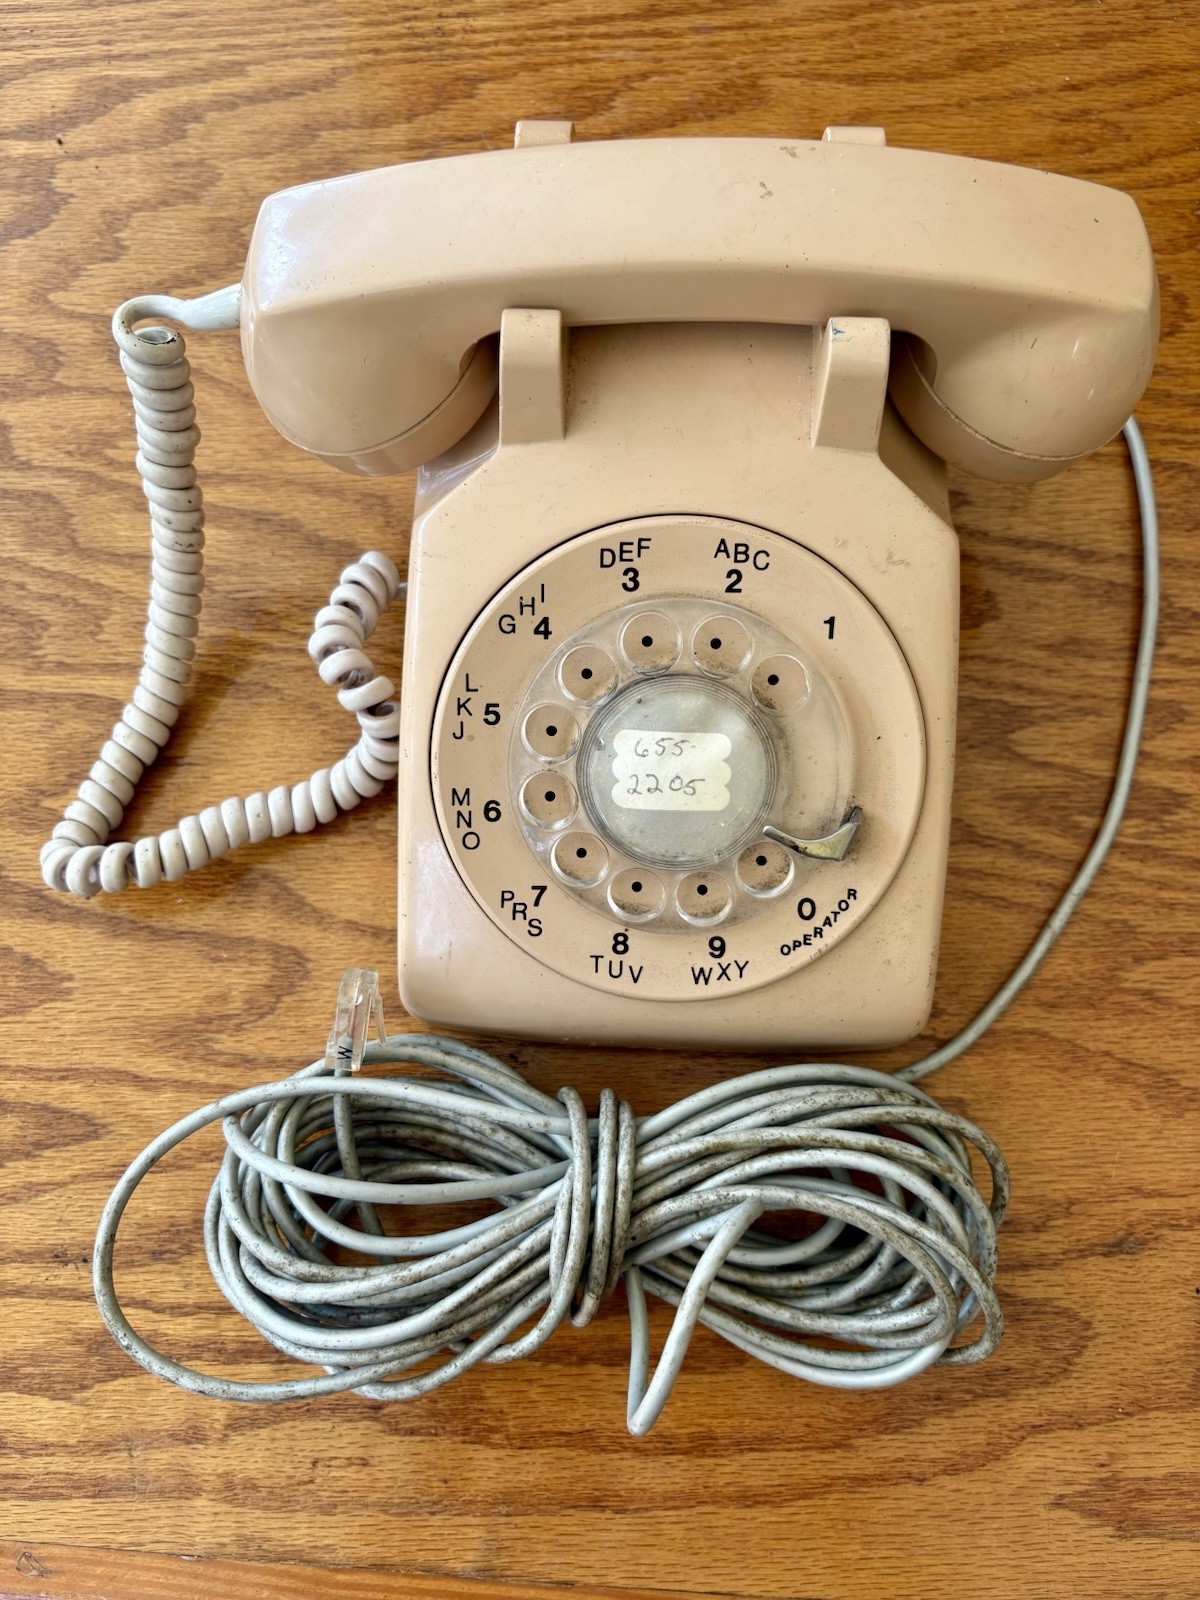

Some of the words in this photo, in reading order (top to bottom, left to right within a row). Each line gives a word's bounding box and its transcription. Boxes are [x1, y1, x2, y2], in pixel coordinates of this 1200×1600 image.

[600, 538, 652, 568] DEF
[713, 538, 770, 570] ABC
[621, 567, 640, 592] 3
[725, 569, 743, 593] 2
[533, 616, 552, 640] 4
[823, 616, 836, 640] 1
[482, 703, 501, 726] 5
[626, 773, 706, 797] 2205
[483, 799, 502, 823] 6
[531, 885, 548, 907] 7
[797, 897, 817, 921] 0
[779, 888, 858, 956] OPERATOR
[611, 932, 629, 955] 8
[708, 936, 726, 959] 9
[590, 955, 644, 984] TUV
[691, 960, 749, 986] WXY
